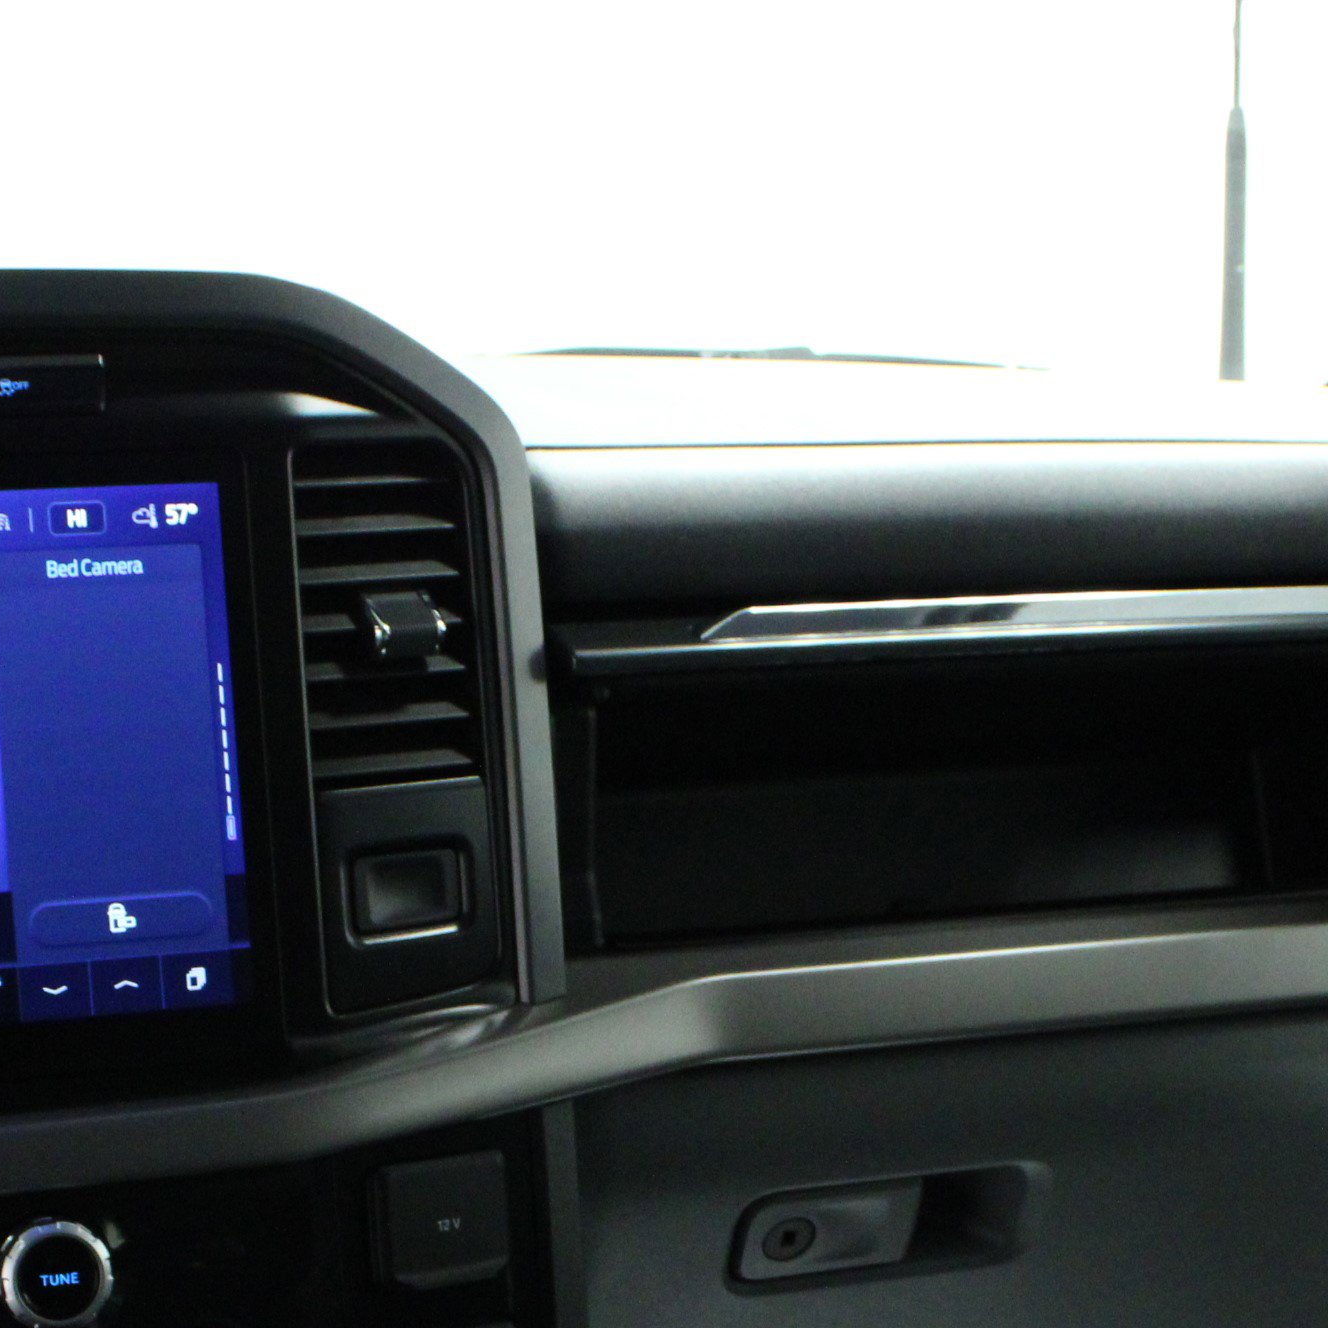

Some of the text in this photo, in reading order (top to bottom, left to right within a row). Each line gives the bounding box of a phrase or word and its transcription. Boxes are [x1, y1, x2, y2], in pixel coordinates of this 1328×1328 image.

[66, 508, 88, 529] HI
[45, 557, 144, 579] Bed Camera
[40, 1271, 80, 1287] TUNE
